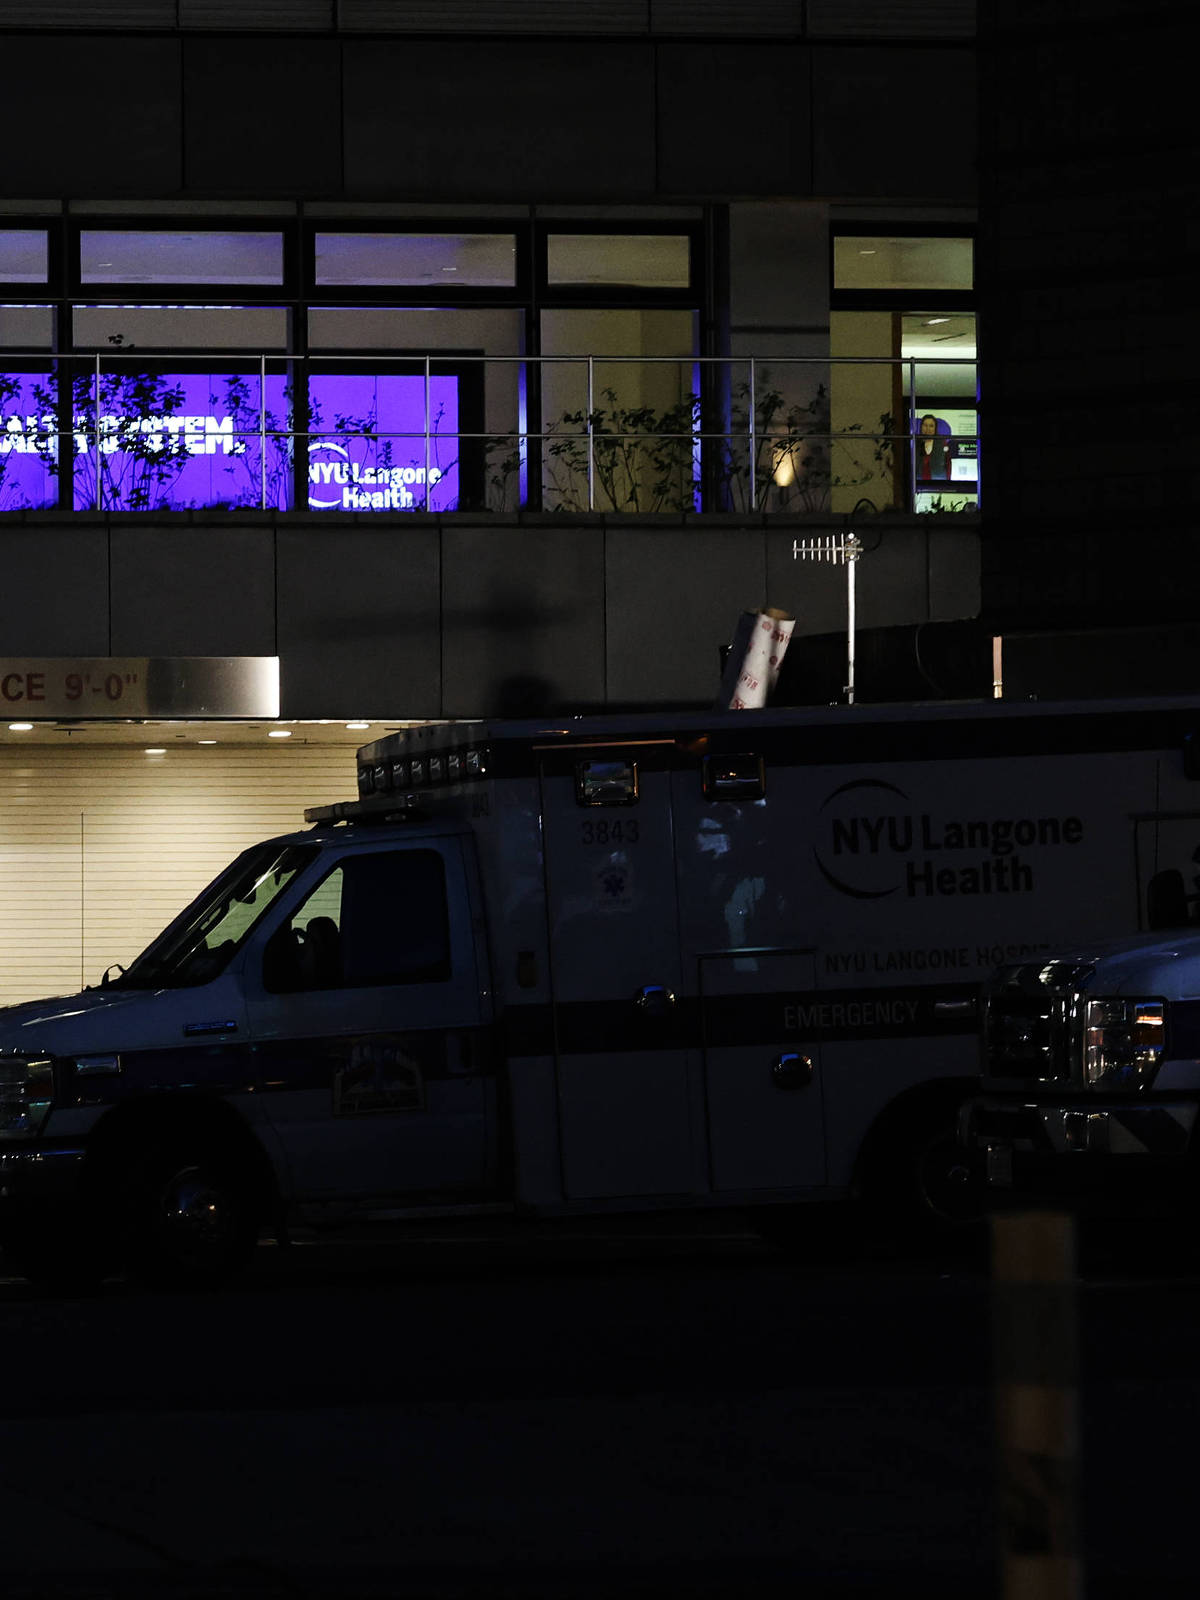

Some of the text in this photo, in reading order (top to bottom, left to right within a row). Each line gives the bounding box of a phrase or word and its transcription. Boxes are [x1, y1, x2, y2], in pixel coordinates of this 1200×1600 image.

[308, 462, 442, 488] NYU Langone
[342, 486, 413, 509] Health
[580, 818, 640, 846] 3843
[831, 814, 1084, 856] NYU Langone
[905, 855, 1034, 898] Health
[825, 951, 867, 974] NYU
[873, 948, 969, 973] LANGONE
[783, 1000, 920, 1031] EMERGENCY
